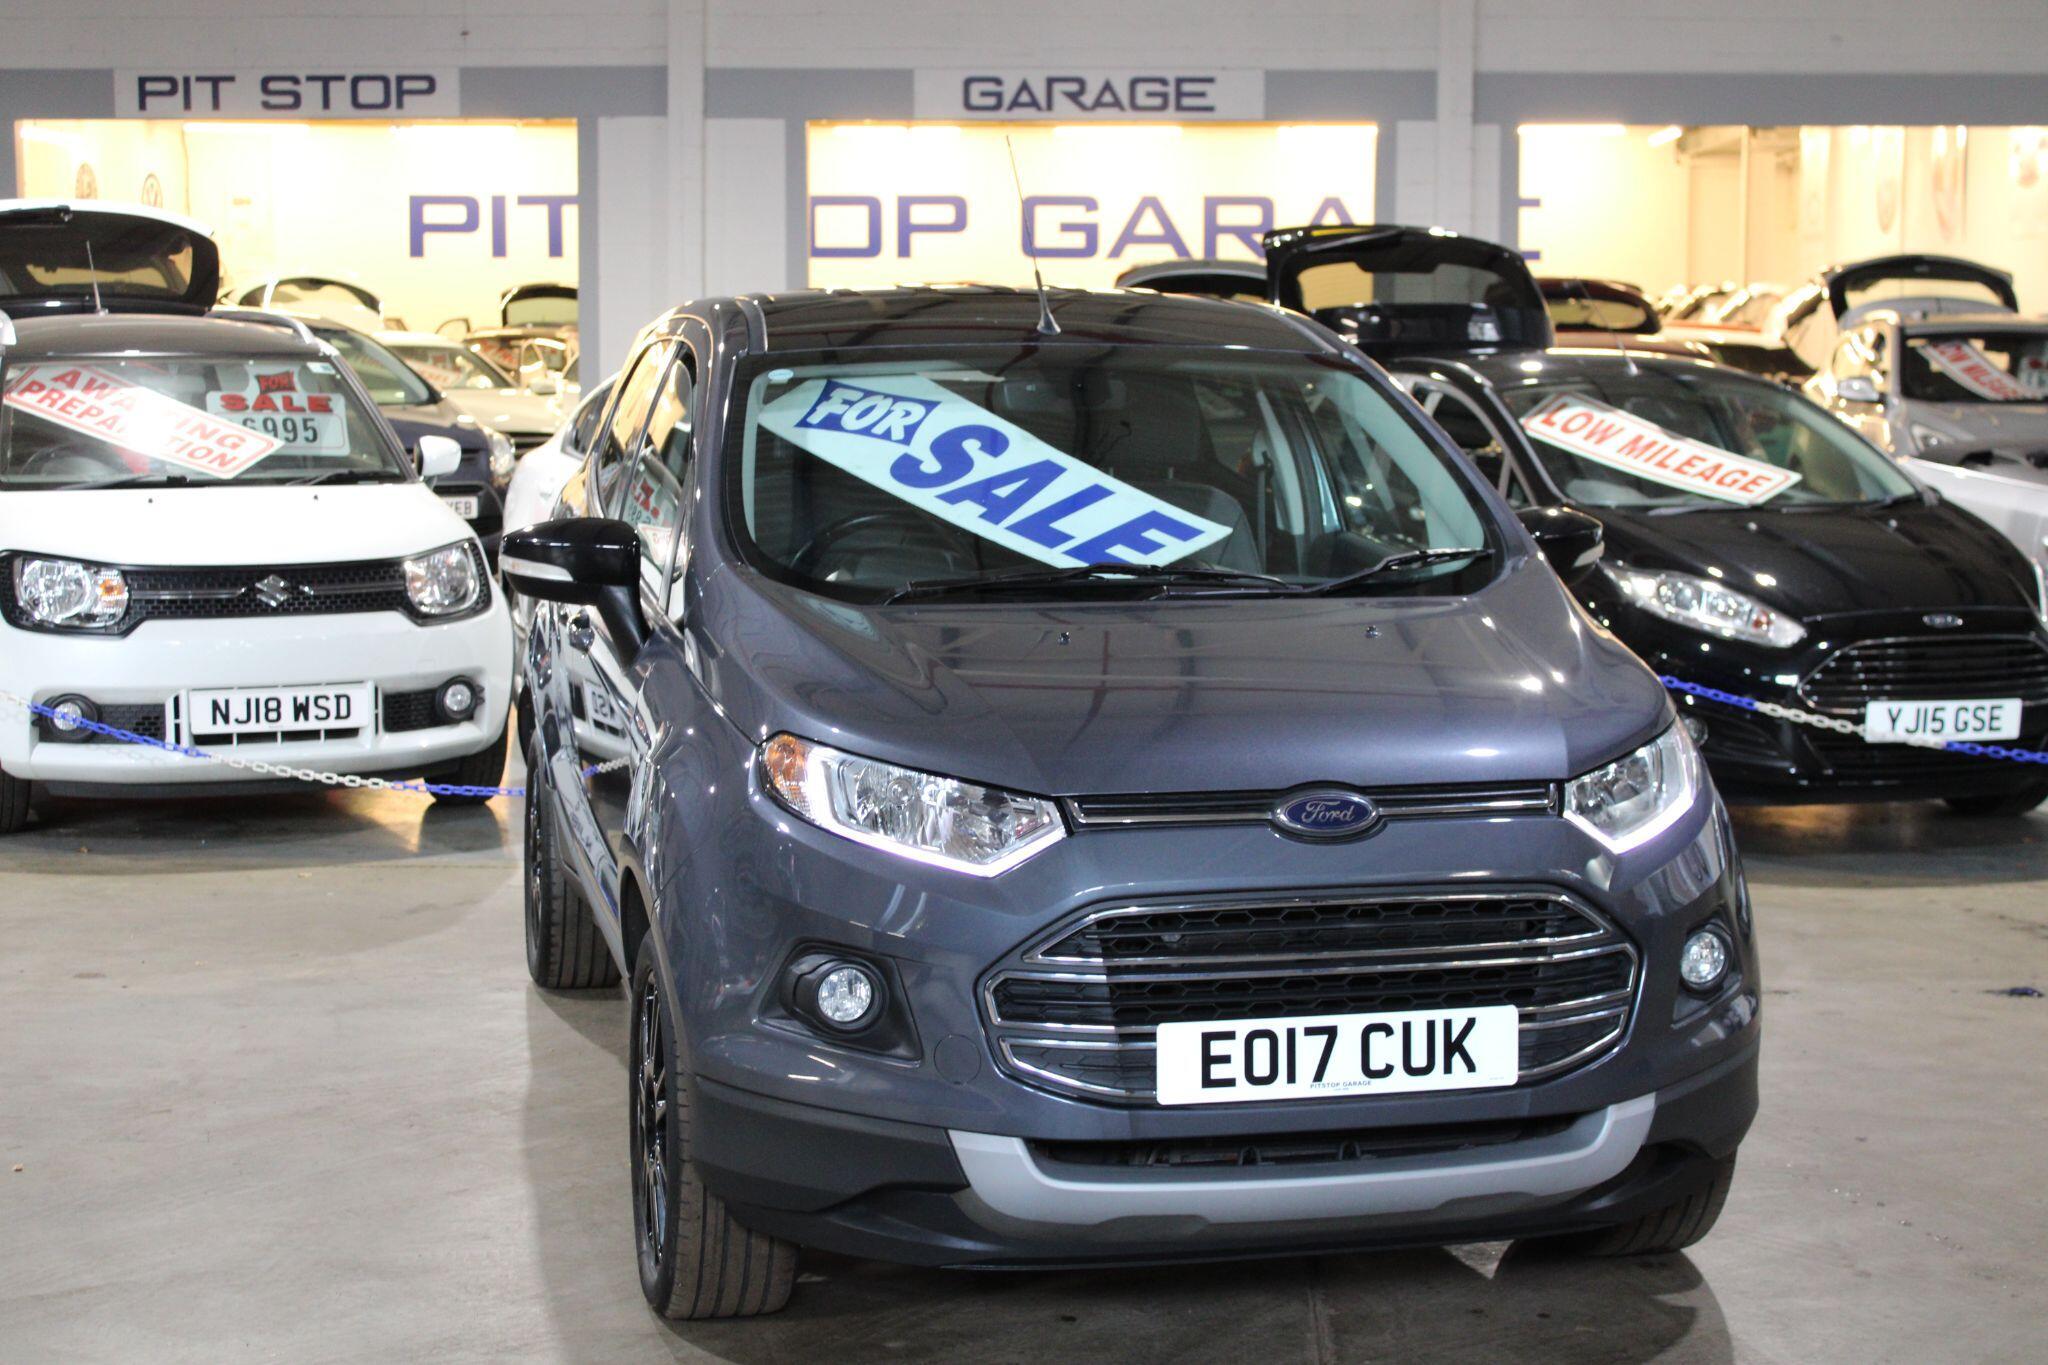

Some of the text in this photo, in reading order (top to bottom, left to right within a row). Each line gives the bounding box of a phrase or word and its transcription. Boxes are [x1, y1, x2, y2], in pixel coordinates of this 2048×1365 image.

[138, 75, 436, 111] PIT STOP
[963, 76, 1215, 111] GARAGE
[409, 196, 579, 257] PIT
[811, 196, 968, 258] OP
[18, 380, 239, 468] PREPATION
[52, 369, 242, 450] AWAING
[220, 394, 333, 413] SALE
[1542, 403, 1773, 493] LOW MILEAGE
[809, 386, 1205, 567] FOR SALE
[211, 694, 351, 726] NJ18 WSD
[1888, 705, 2003, 734] YJ15 GSE
[1301, 800, 1355, 823] Ford
[1201, 1017, 1477, 1089] EO17 CUK
